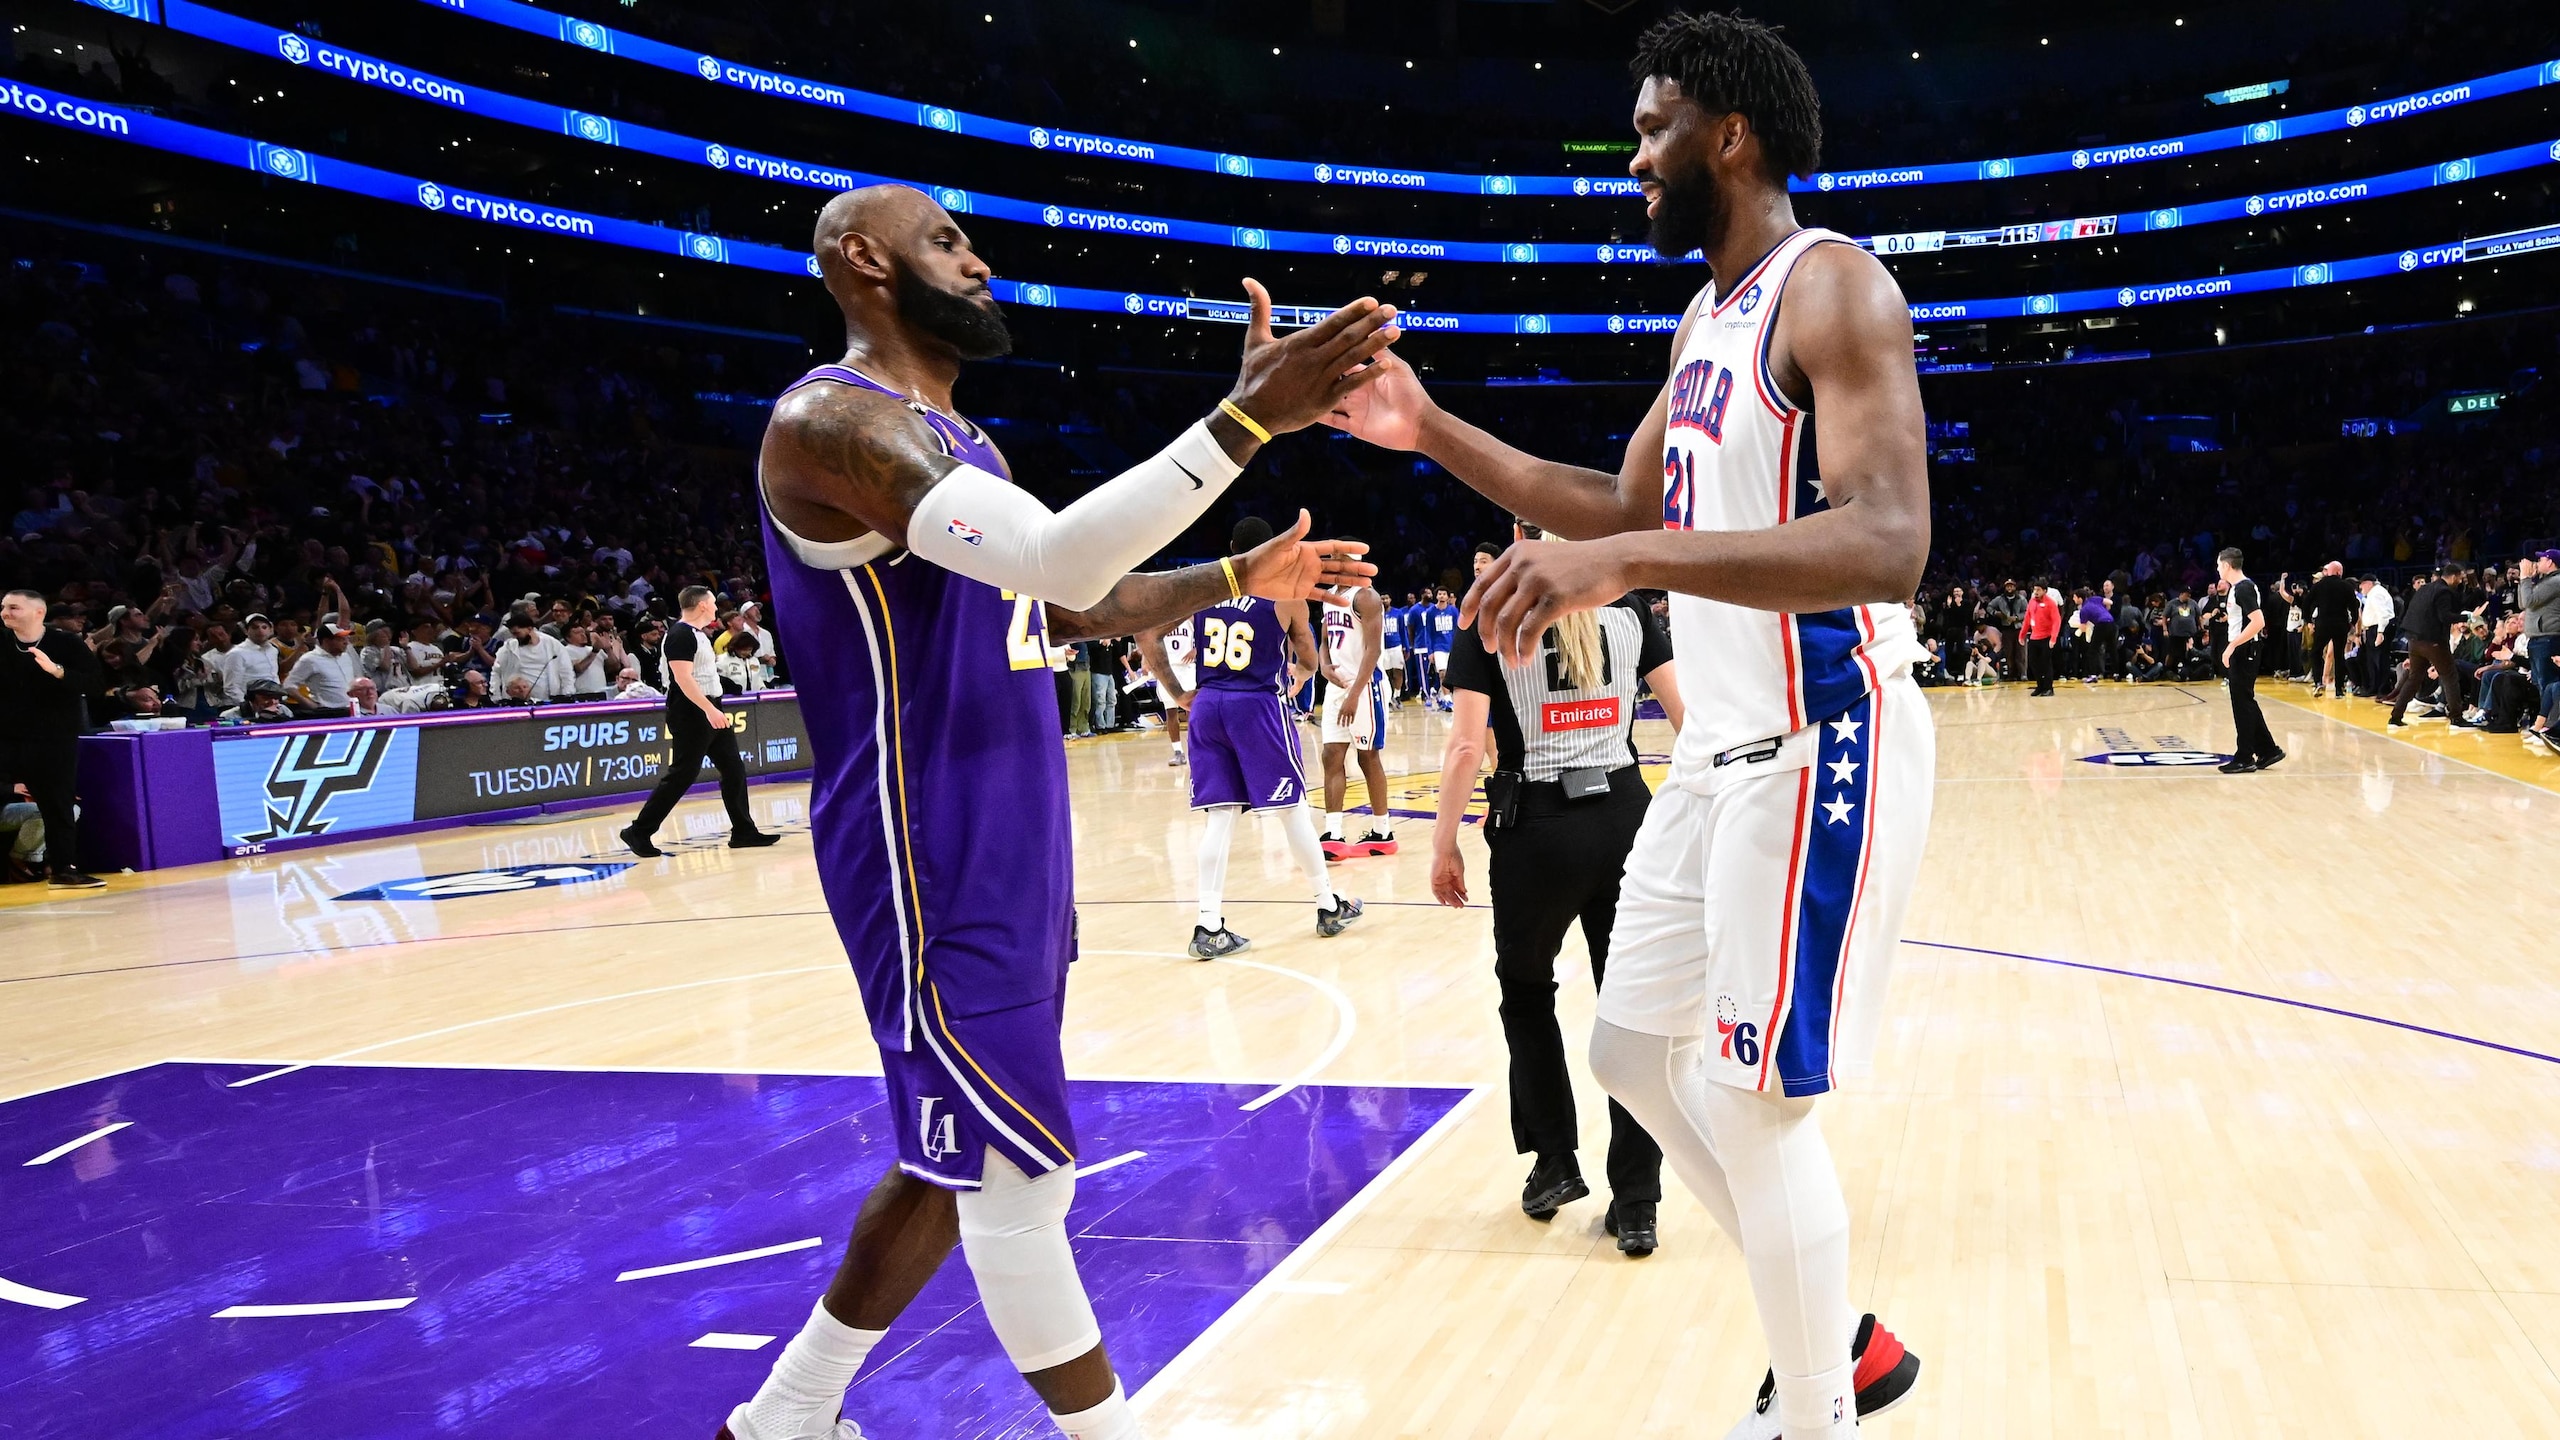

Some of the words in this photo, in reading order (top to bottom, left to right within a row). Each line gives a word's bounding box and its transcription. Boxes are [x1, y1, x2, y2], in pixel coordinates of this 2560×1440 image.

[318, 50, 464, 105] crypto.com
[727, 68, 844, 105] crypto.com
[0, 85, 128, 134] to.com
[2371, 87, 2470, 118] crypto.com
[1055, 133, 1154, 159] crypto.com
[2094, 142, 2183, 163] crypto.com
[735, 154, 853, 188] crypto.com
[1336, 170, 1425, 186] crypto.com
[1838, 171, 1923, 187] crypto.com
[1594, 180, 1641, 195] crypto
[2269, 184, 2367, 208] crypto.com
[452, 195, 593, 234] crypto.com
[1068, 213, 1168, 234] crypto.com
[1959, 235, 1987, 244] 76ers
[2007, 226, 2038, 243] 115
[1355, 241, 1444, 257] crypto.com
[1888, 237, 1914, 252] 0.0
[1933, 239, 1940, 248] 4
[2487, 244, 2511, 254] UCLA
[2513, 240, 2533, 250] Yardi
[2140, 280, 2230, 301] crypto.com
[1208, 310, 1230, 318] UCLA
[1231, 312, 1249, 320] Yardi
[1628, 317, 1678, 332] crypto
[2467, 397, 2496, 409] DEL
[1663, 447, 1695, 531] 21
[1215, 595, 1256, 613] MART
[1172, 640, 1179, 650] 0
[1204, 617, 1255, 671] 36
[1550, 707, 1613, 724] Emirates
[544, 721, 630, 751] SPURS
[1355, 736, 1368, 745] 76
[766, 745, 782, 762] NBA
[783, 744, 797, 760] APP
[469, 761, 581, 797] TUESDAY
[599, 755, 644, 782] 7:30
[645, 753, 661, 765] PM
[645, 764, 658, 776] PT
[1266, 777, 1293, 802] LA
[235, 843, 266, 855] anc
[1717, 1015, 1759, 1066] 76
[917, 1096, 962, 1163] LA
